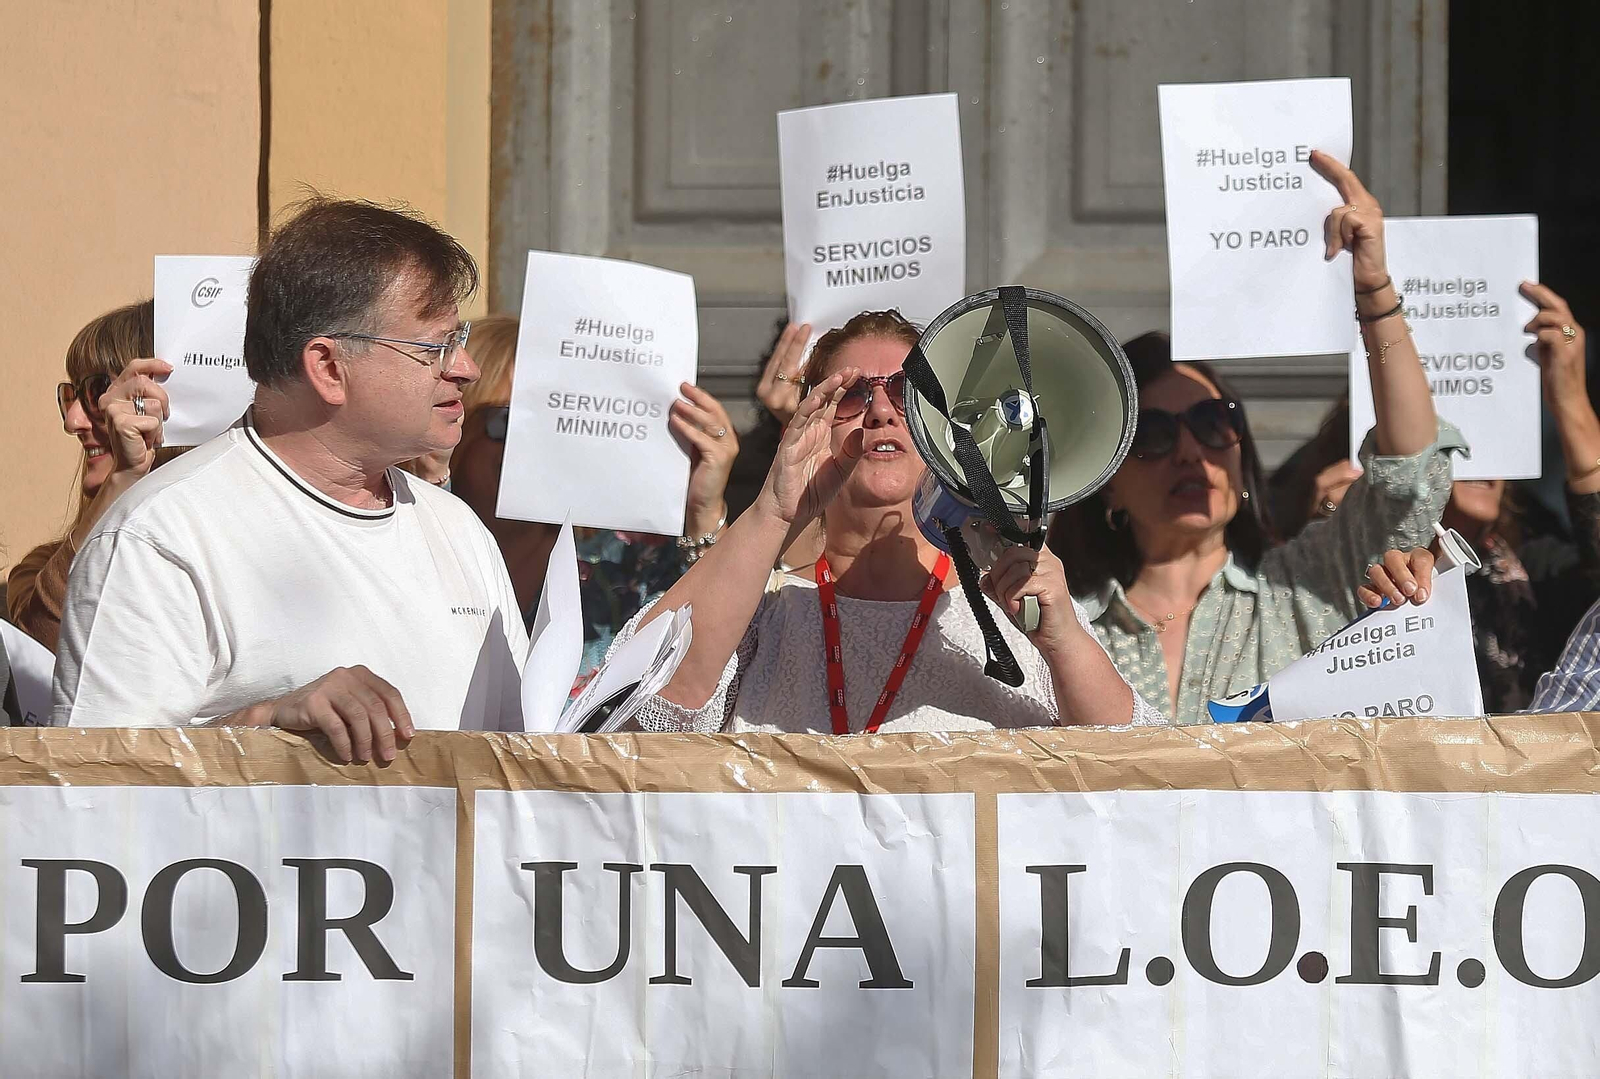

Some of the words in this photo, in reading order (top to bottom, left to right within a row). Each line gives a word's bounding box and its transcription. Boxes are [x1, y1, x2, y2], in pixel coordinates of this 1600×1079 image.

[1197, 146, 1288, 169] #Huelga
[1295, 145, 1309, 163] E
[827, 160, 911, 182] #Huelga
[1219, 172, 1303, 191] Justicia
[816, 183, 925, 209] EnJusticia
[813, 236, 932, 263] SERVICIOS
[1210, 231, 1242, 249] YO
[1250, 228, 1309, 248] PARO
[826, 261, 921, 287] MÍNIMOS
[1403, 278, 1487, 297] #Huelga
[1405, 301, 1500, 319] nJusticia
[574, 318, 655, 344] #Huelga
[560, 340, 664, 366] EnJusticia
[548, 392, 662, 418] SERVICIOS
[556, 414, 648, 440] MÍNIMOS
[1405, 616, 1434, 633] En
[1326, 643, 1416, 675] Justicia
[1364, 695, 1434, 717] PARO
[20, 857, 414, 983] POR
[521, 861, 915, 989] UNA
